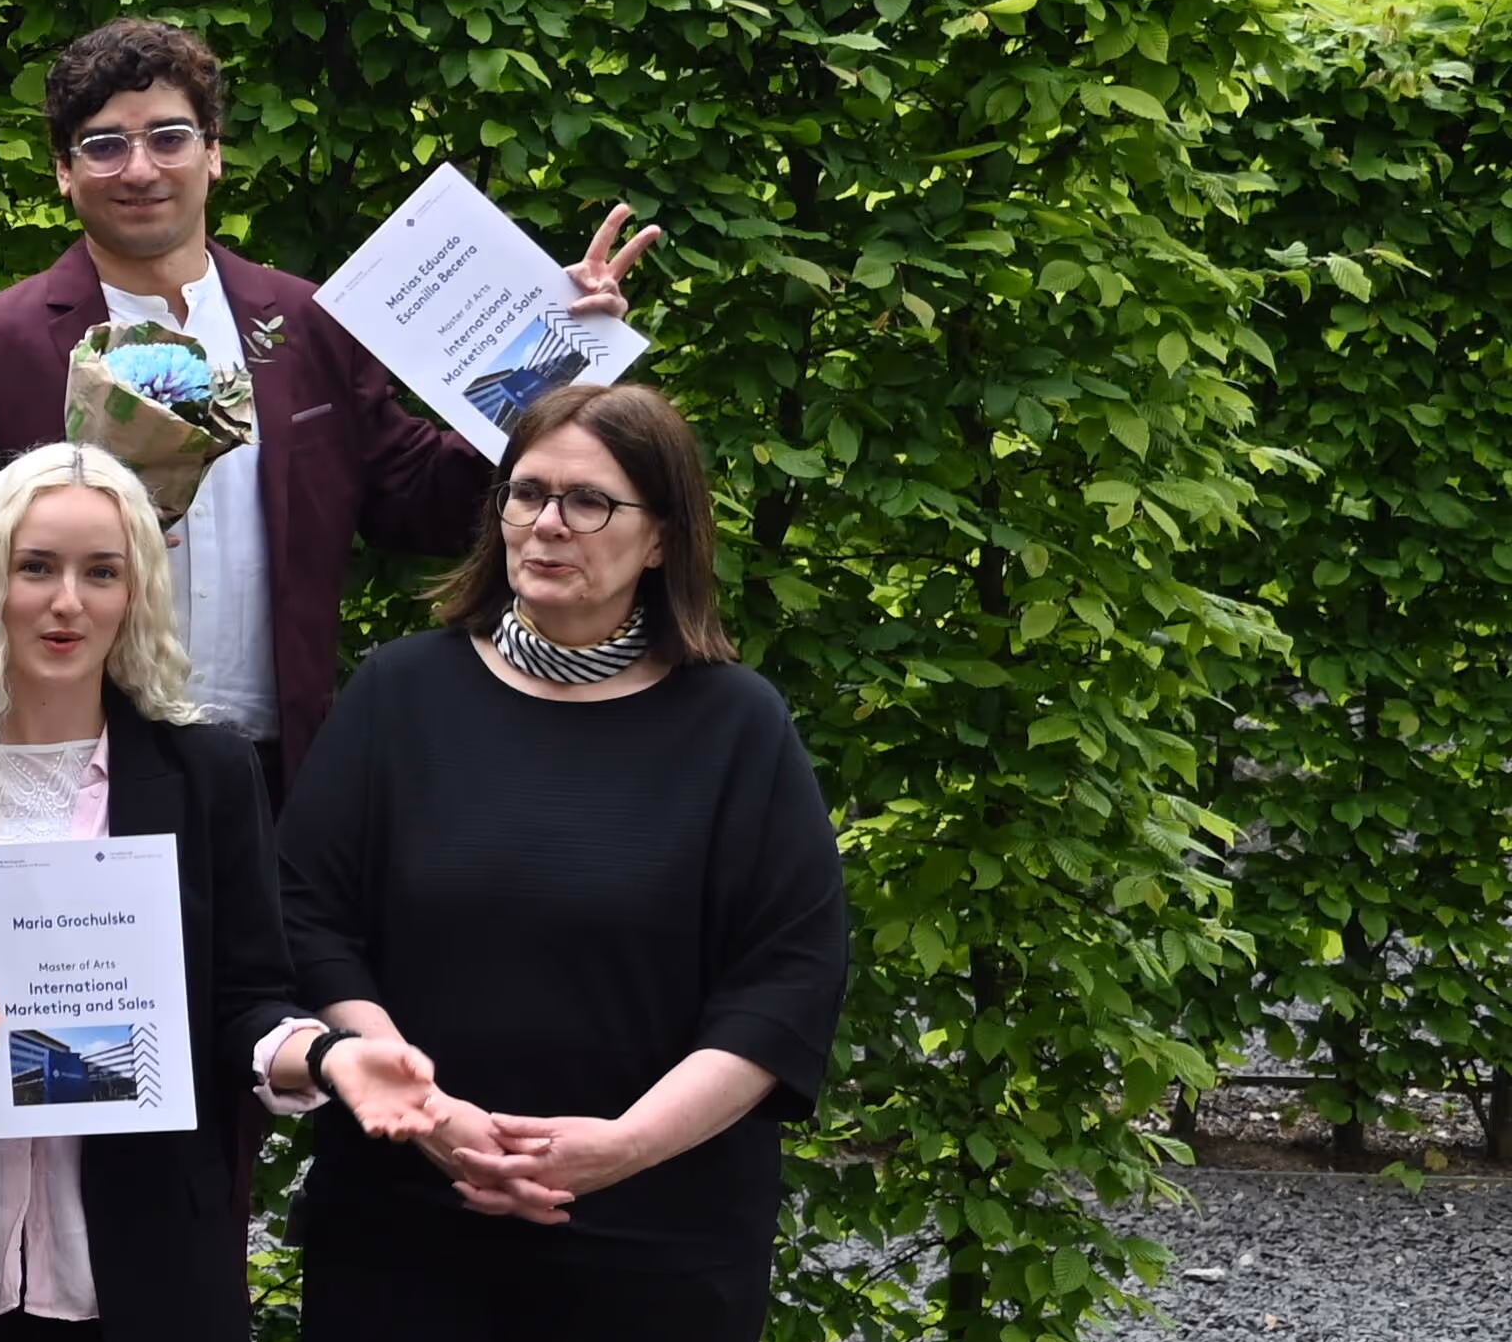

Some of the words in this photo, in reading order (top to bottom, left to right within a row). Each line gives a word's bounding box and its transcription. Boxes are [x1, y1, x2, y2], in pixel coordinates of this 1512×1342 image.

[384, 275, 422, 310] Matias
[417, 235, 461, 277] Eduardo
[436, 244, 478, 284] Becerra
[436, 308, 465, 336] Master
[464, 298, 474, 311] of
[472, 283, 492, 303] Arts
[443, 287, 513, 357] International
[441, 333, 498, 386] Marketing
[494, 310, 516, 335] and
[512, 286, 543, 315] Sales
[12, 915, 53, 931] Maria
[56, 910, 136, 928] Grochulska
[38, 962, 76, 973] Master
[78, 958, 90, 972] of
[92, 959, 116, 970] Arts
[29, 976, 128, 996] International
[4, 999, 81, 1018] Marketing
[85, 997, 114, 1013] and
[117, 996, 156, 1011] Sales
